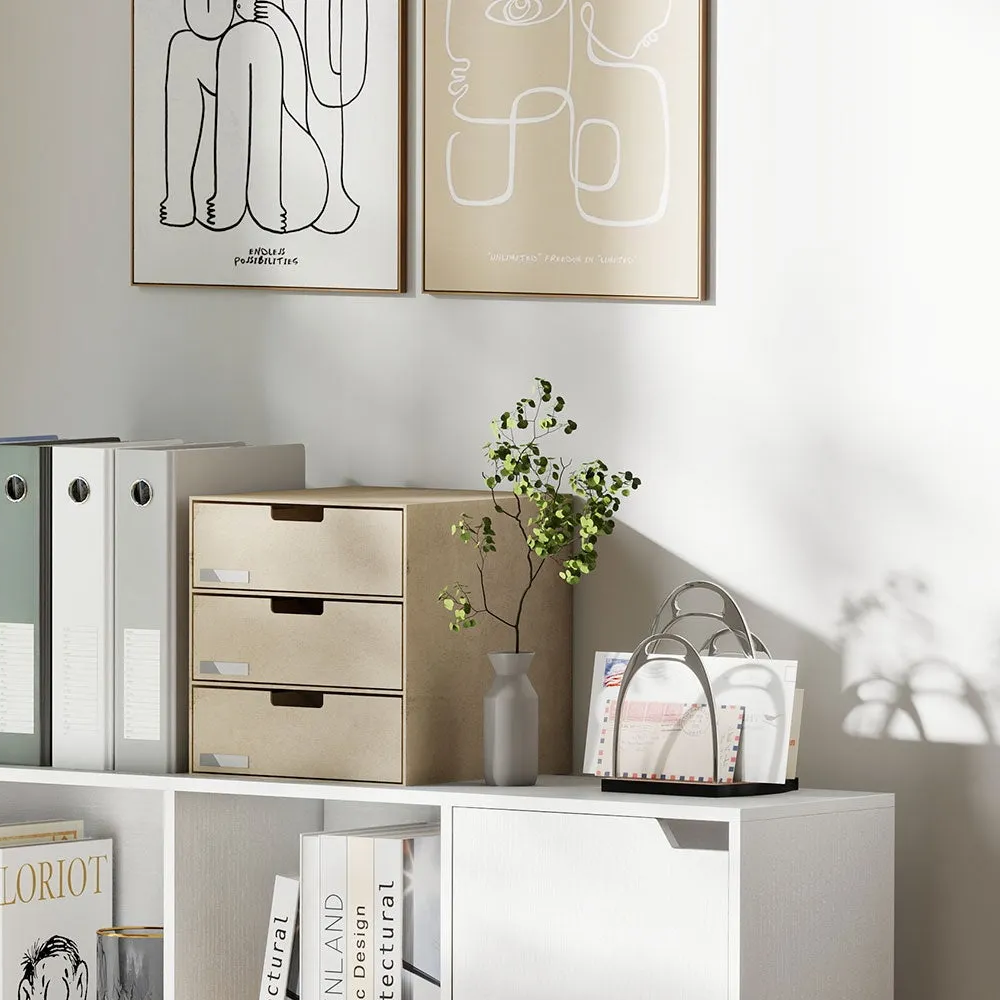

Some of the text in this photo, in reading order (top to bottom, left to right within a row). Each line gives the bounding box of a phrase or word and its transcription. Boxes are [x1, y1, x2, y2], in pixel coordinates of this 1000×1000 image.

[234, 256, 298, 266] POSSIBILITIES
[249, 247, 285, 256] ENDLESS
[0, 854, 108, 906] LORIOT
[353, 905, 368, 978] Design
